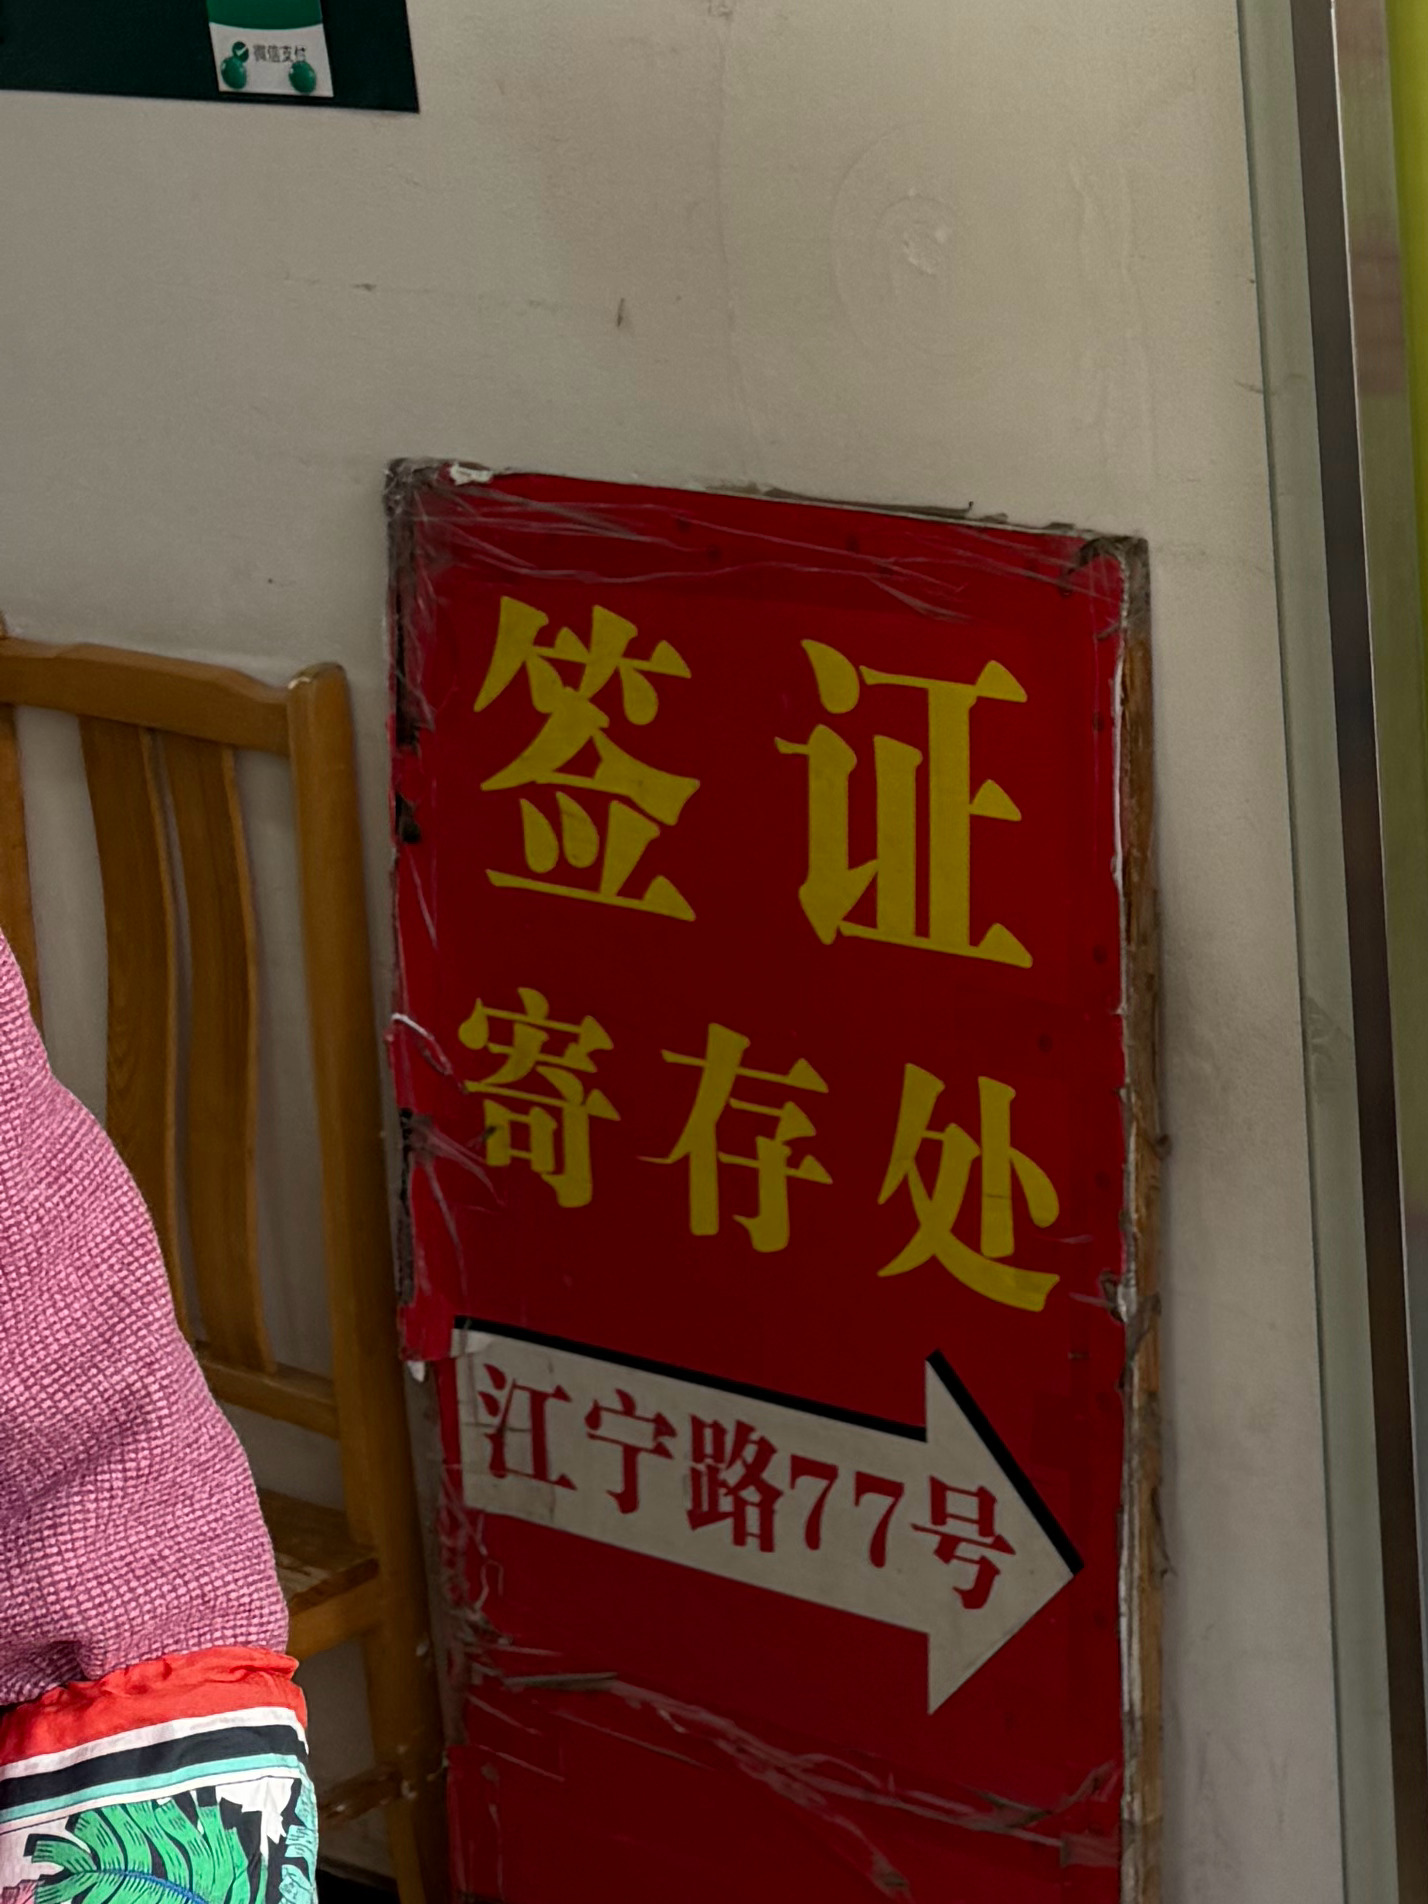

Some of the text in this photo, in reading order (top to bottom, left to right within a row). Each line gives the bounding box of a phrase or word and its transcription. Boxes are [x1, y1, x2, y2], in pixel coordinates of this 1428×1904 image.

[472, 595, 1034, 969] 签证
[458, 987, 1061, 1313] 寄存处
[477, 1363, 1017, 1610] 江宁路77号
